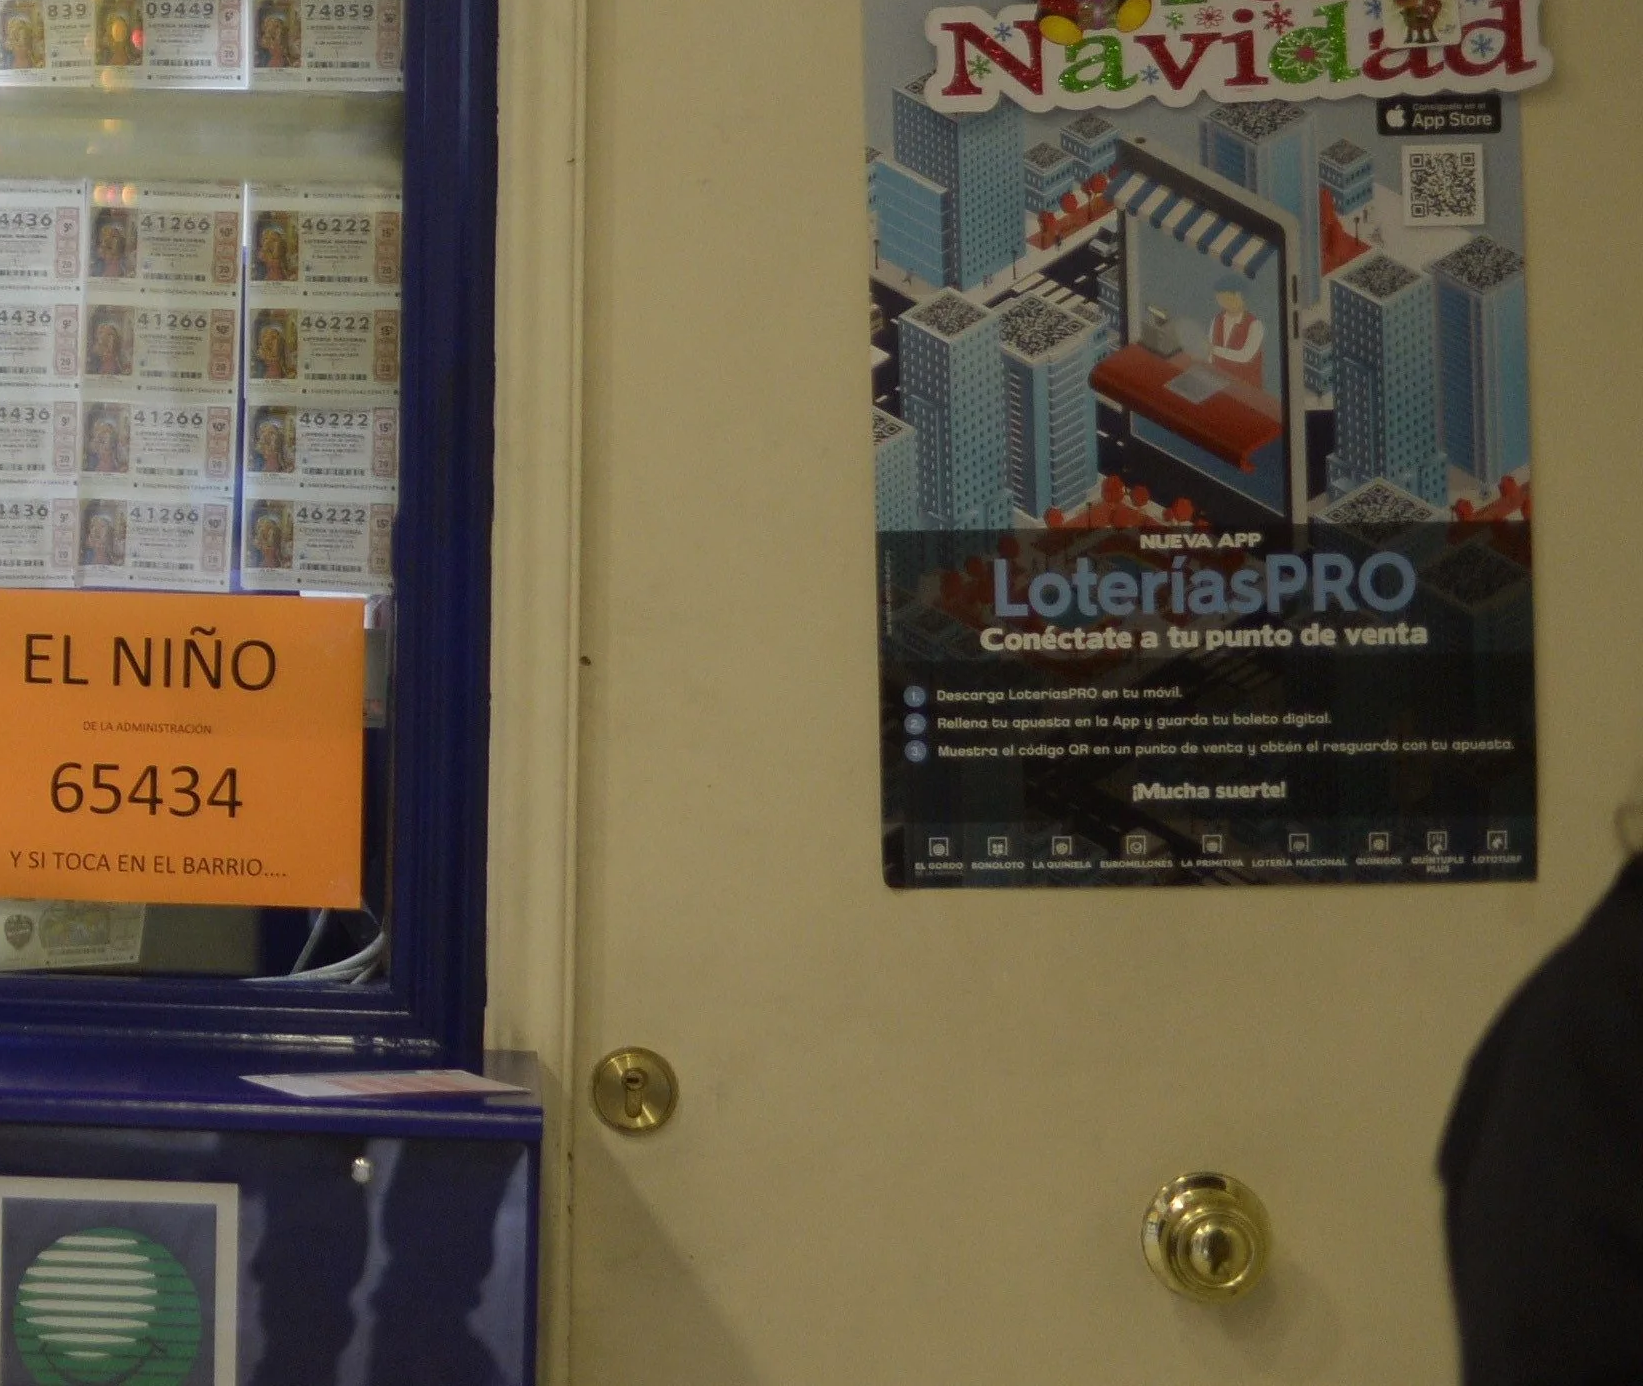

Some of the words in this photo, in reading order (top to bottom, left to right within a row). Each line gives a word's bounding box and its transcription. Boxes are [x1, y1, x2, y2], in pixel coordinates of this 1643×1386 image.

[1412, 112, 1446, 130] App
[1450, 112, 1493, 127] Store
[140, 216, 210, 232] 41266
[301, 218, 370, 233] 46222
[1140, 533, 1211, 549] NUEVA
[1217, 532, 1261, 548] APP
[994, 550, 1416, 618] LoteríasPRO
[980, 626, 1132, 653] Conéctate
[1141, 632, 1158, 650] a
[1168, 629, 1199, 650] tu
[1206, 627, 1293, 653] punto
[1301, 623, 1334, 648] de
[1347, 623, 1428, 647] venta
[24, 633, 89, 685] EL
[114, 626, 277, 691] NIÑO
[937, 690, 1004, 703] Descarga
[1102, 690, 1118, 699] en
[1123, 688, 1139, 699] tu
[937, 717, 987, 729] Rellena
[992, 718, 1009, 728] tu
[1012, 718, 1070, 731] apuesta
[1075, 717, 1091, 727] en
[1095, 716, 1109, 726] la
[1113, 715, 1139, 729] App
[1144, 717, 1153, 730] y
[1156, 714, 1207, 729] guarda
[1212, 715, 1228, 726] tu
[1233, 713, 1278, 725] boleto
[1282, 712, 1332, 729] digital.
[49, 761, 243, 819] 65434
[1132, 782, 1208, 802] ¡Mucha
[1215, 780, 1286, 801] suerte!
[10, 851, 21, 868] Y
[28, 852, 45, 869] SI
[53, 852, 110, 872] TOCA
[118, 854, 145, 872] EN
[154, 855, 175, 874] EL
